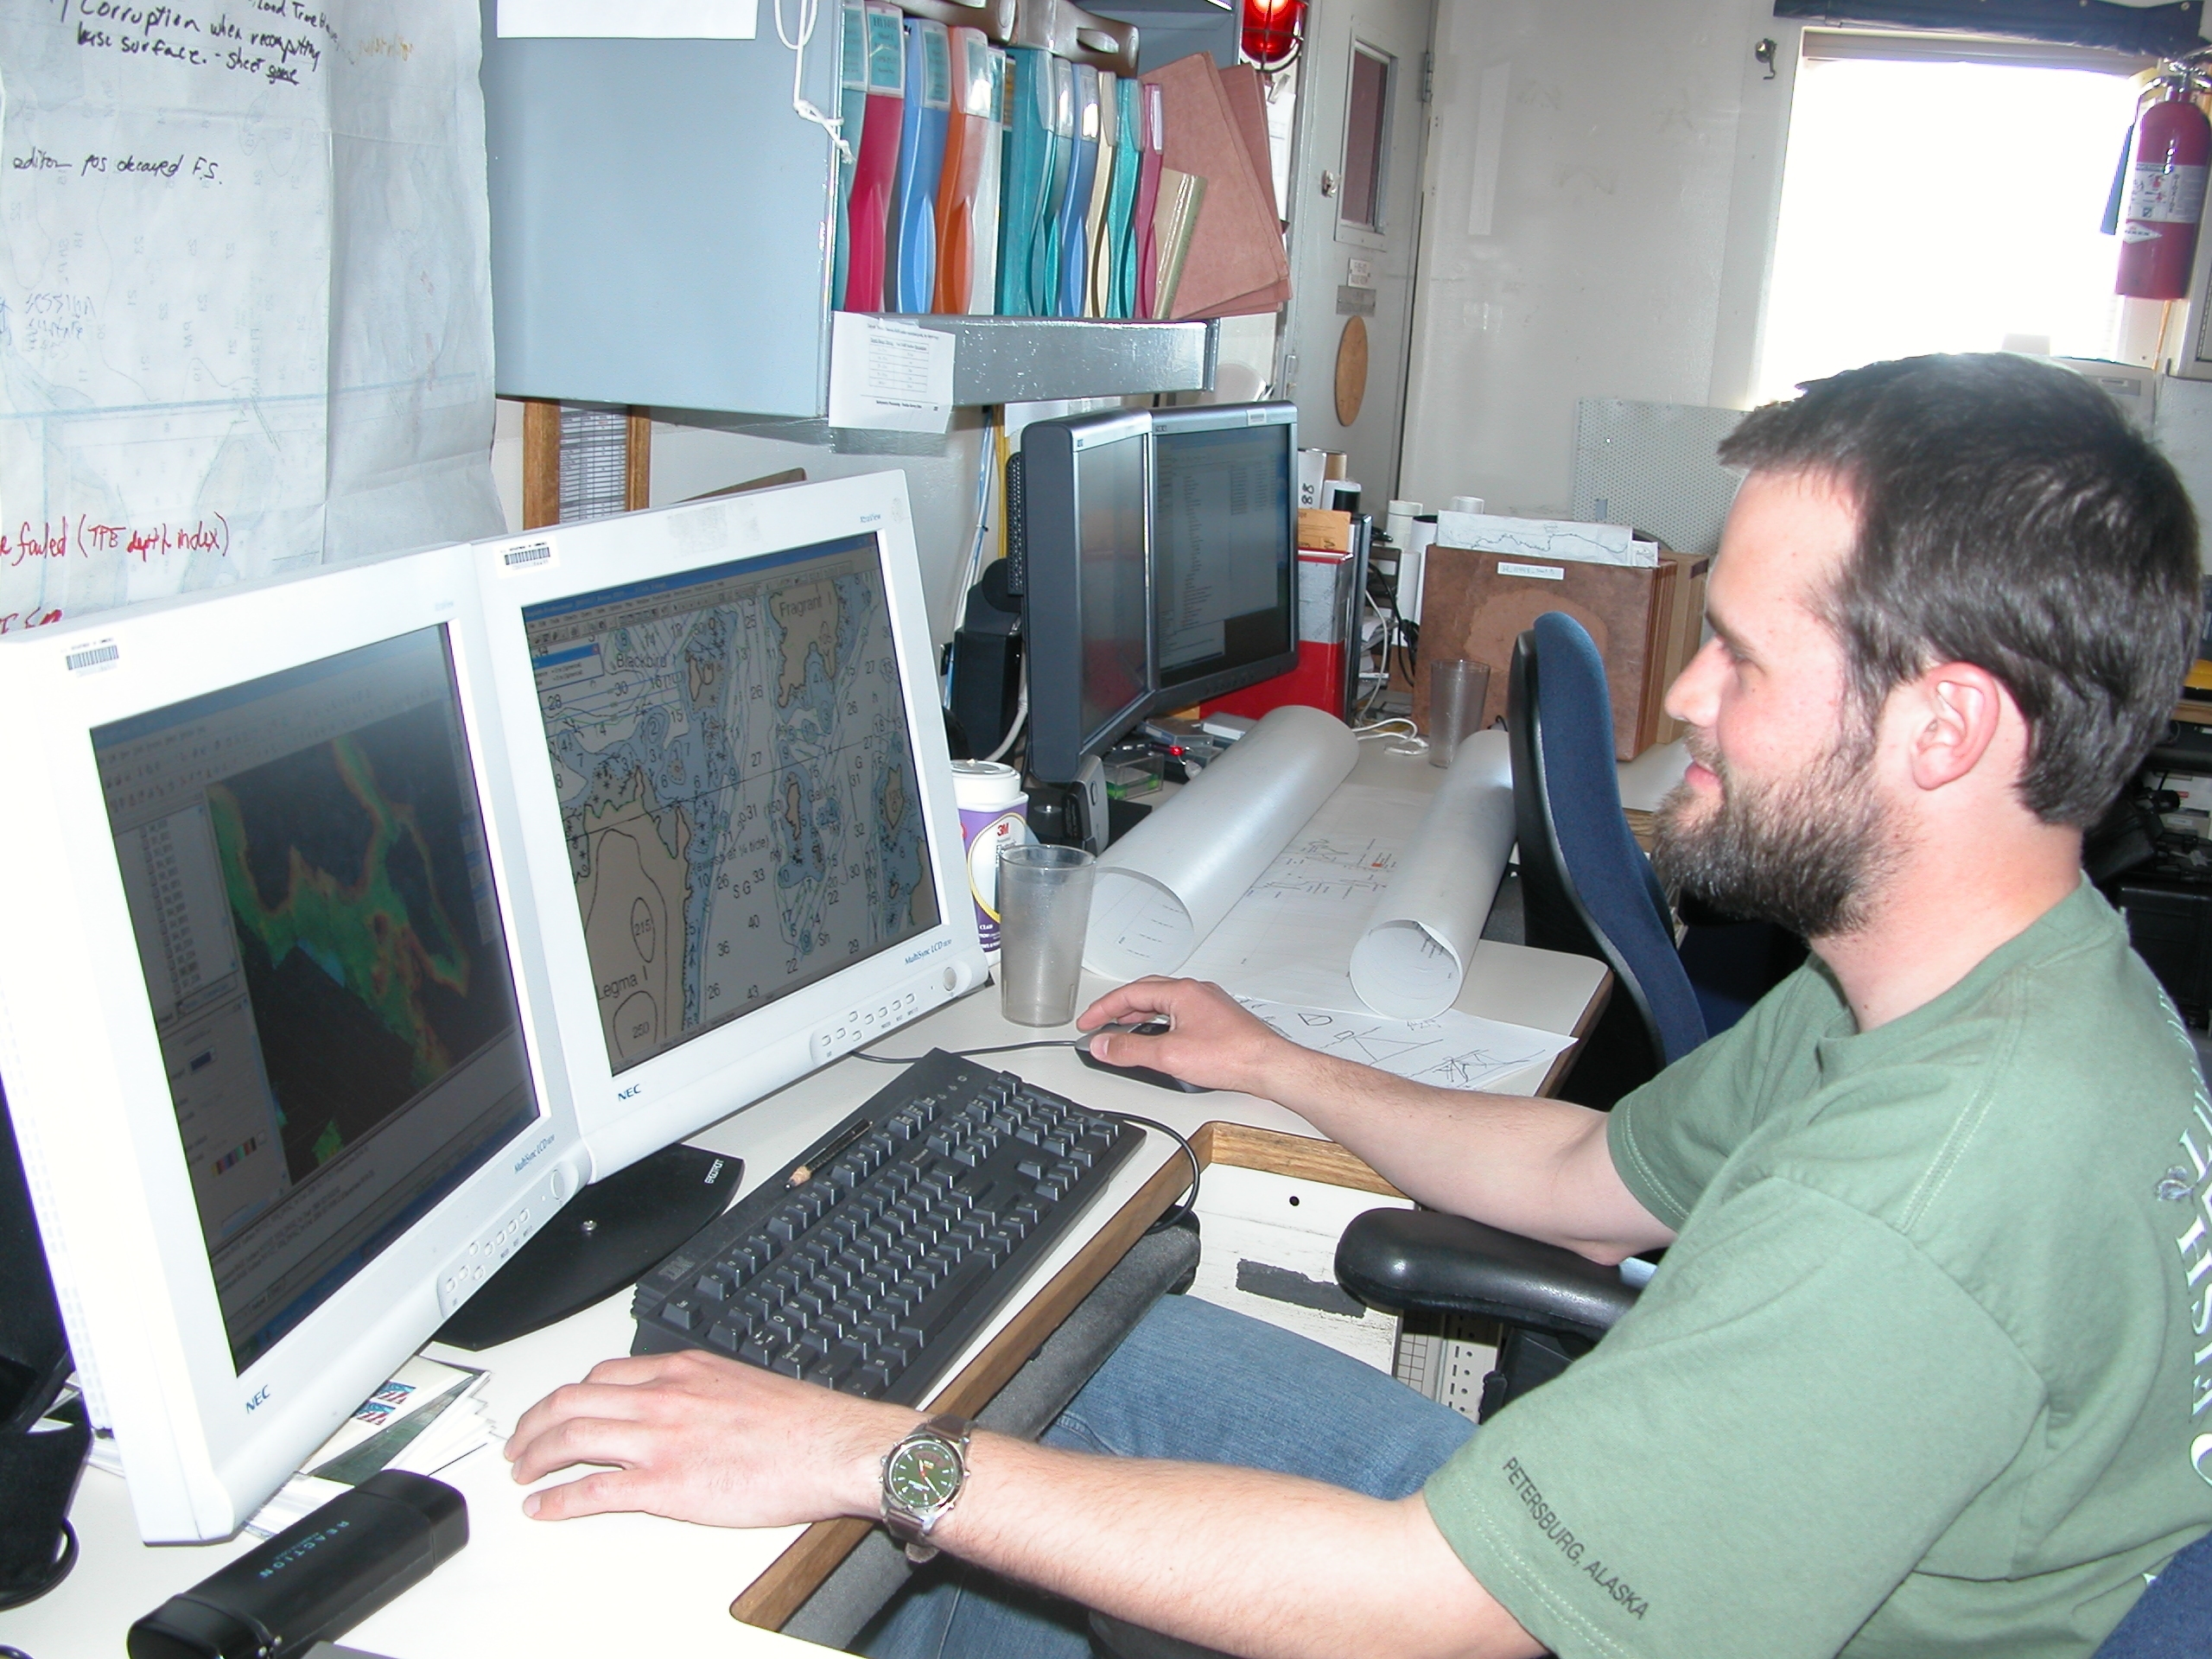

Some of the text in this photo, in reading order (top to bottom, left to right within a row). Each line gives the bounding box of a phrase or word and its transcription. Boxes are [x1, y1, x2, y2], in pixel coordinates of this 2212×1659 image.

[80, 0, 200, 35] Corruption
[210, 15, 242, 41] when
[745, 614, 757, 630] 25
[865, 660, 875, 675] 27
[751, 684, 763, 700] 26
[846, 702, 858, 716] 26
[751, 752, 762, 767] 27
[996, 823, 1009, 836] 3M
[716, 873, 730, 890] 26
[752, 868, 766, 884] 33
[827, 889, 839, 906] 22
[634, 919, 652, 937] 215
[748, 914, 760, 931] 40
[717, 940, 730, 957] 36
[848, 938, 860, 954] 29
[785, 957, 798, 975] 22
[708, 982, 721, 1001] 26
[747, 984, 760, 1001] 43
[632, 1021, 650, 1039] 250
[618, 1084, 642, 1102] NEC
[245, 1383, 270, 1414] NEC
[1503, 1457, 1649, 1620] PETERSBURG, ALASKA
[259, 1521, 350, 1579] REACTION
